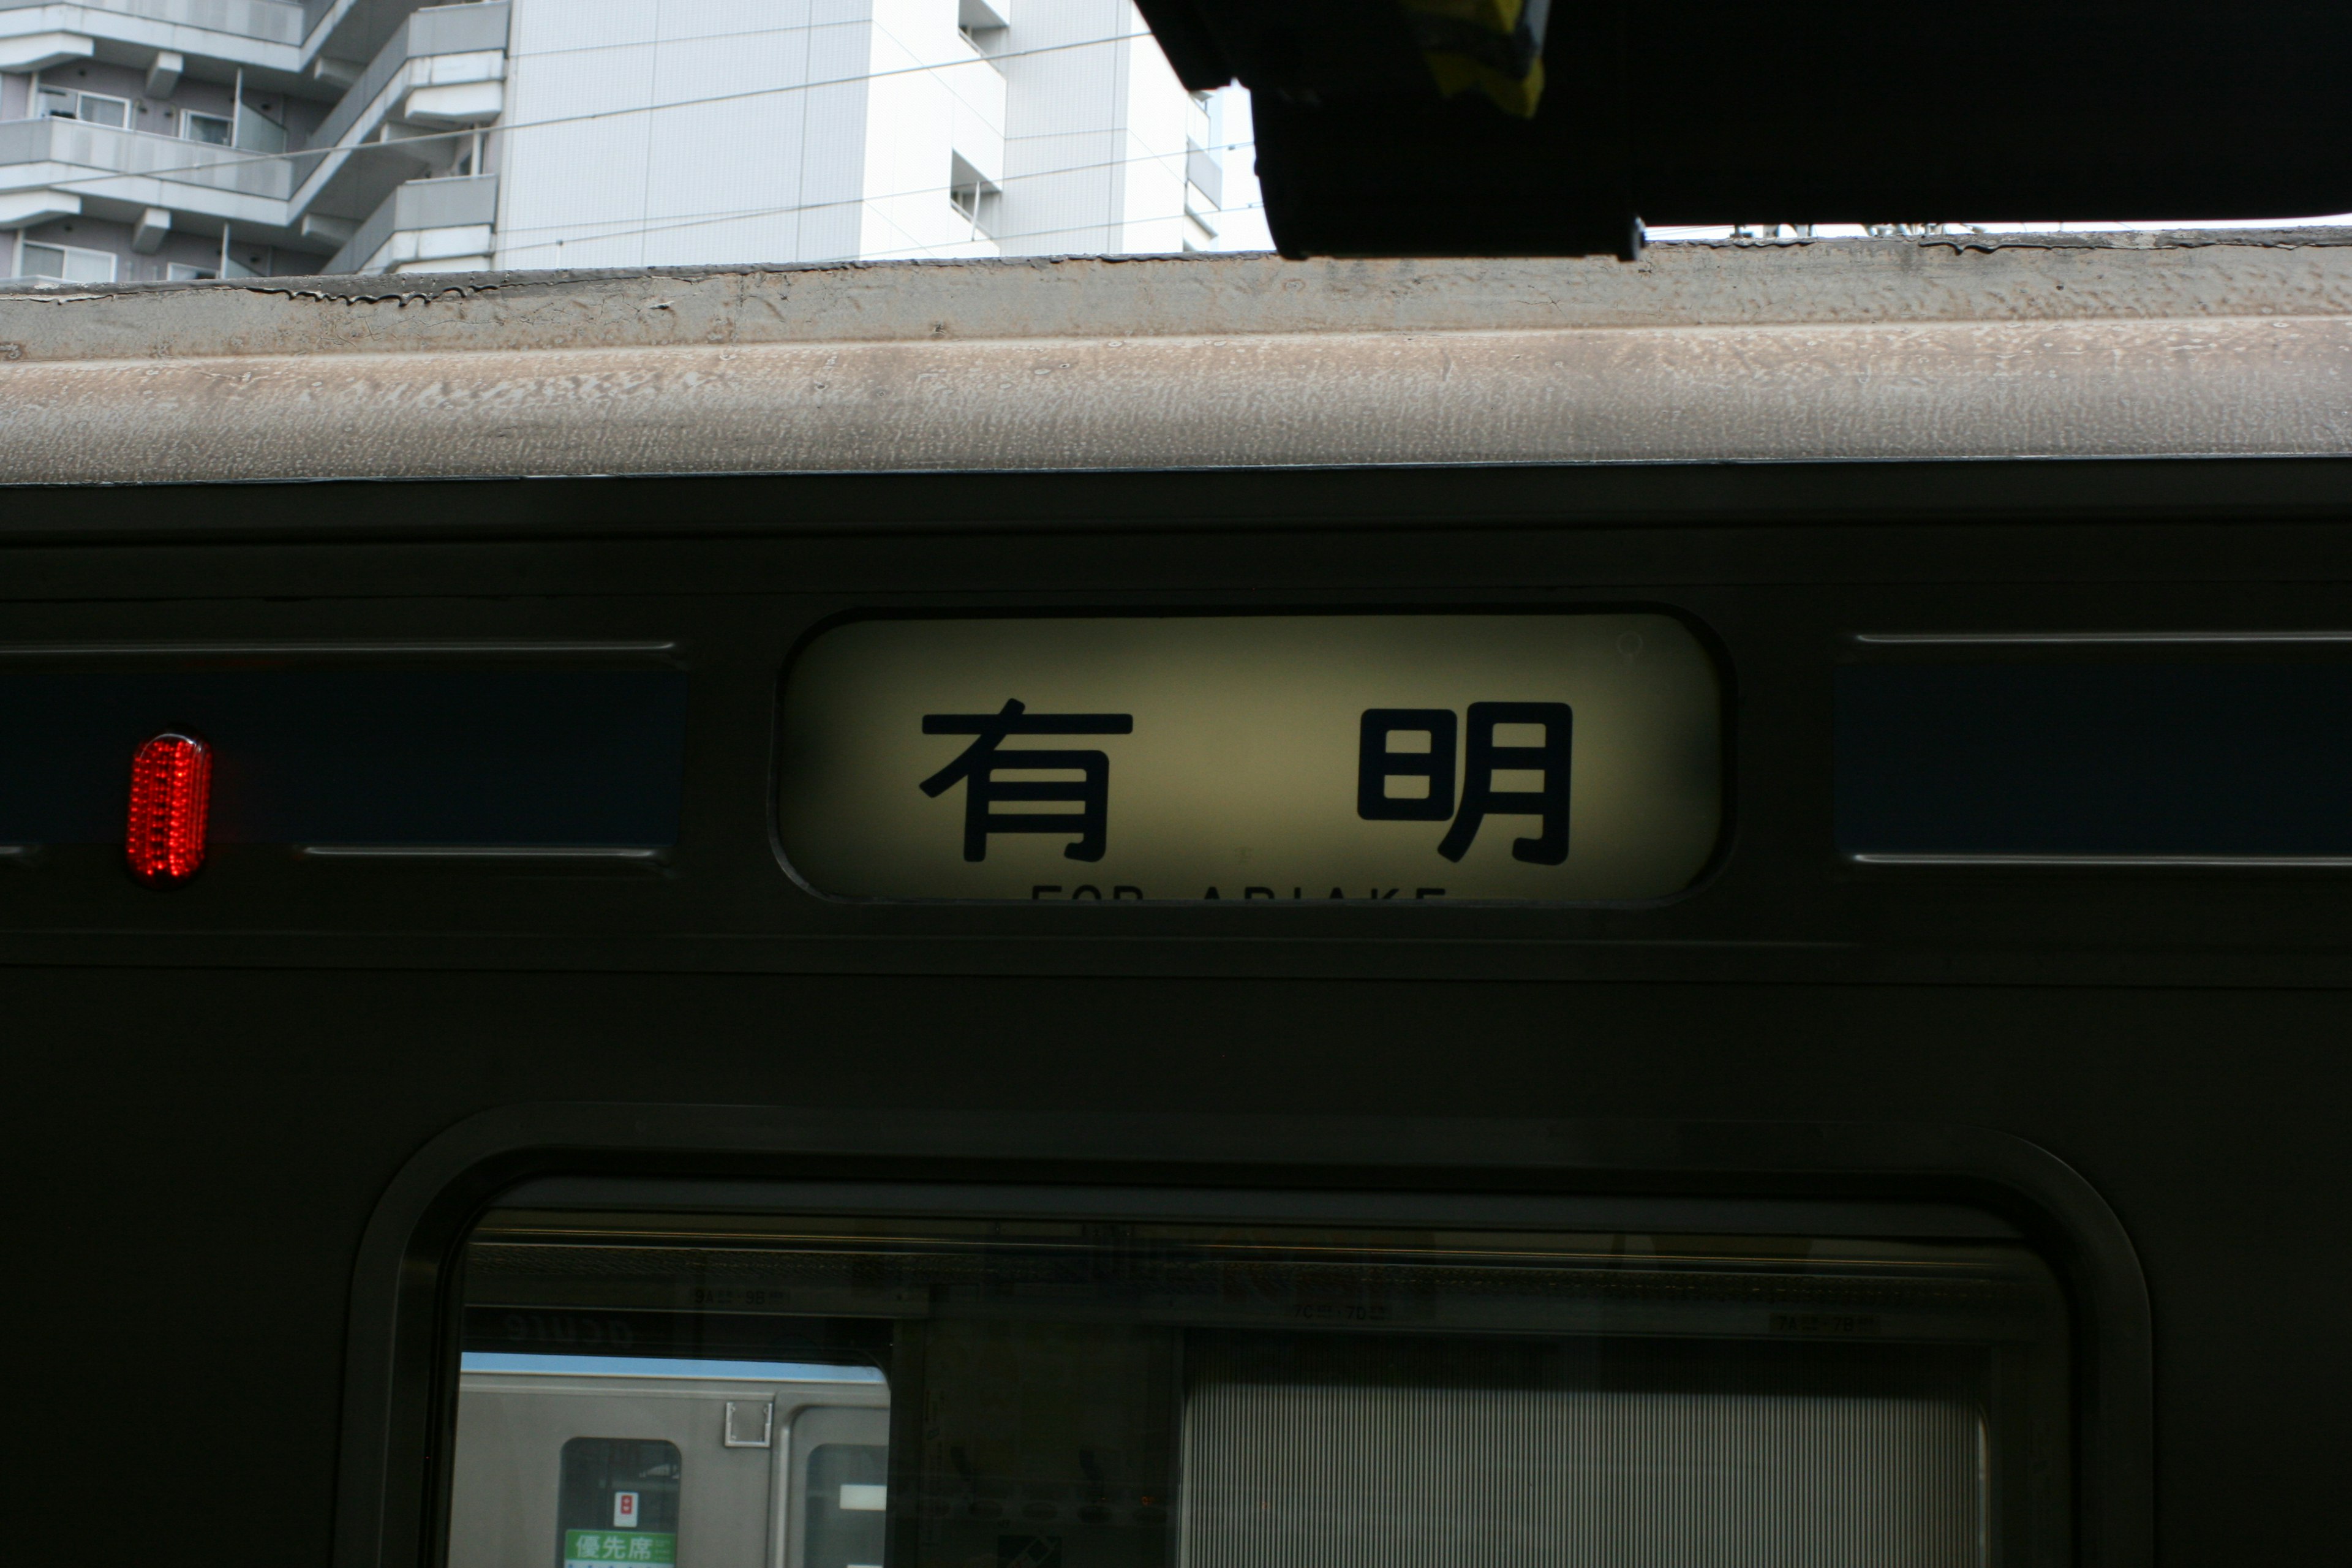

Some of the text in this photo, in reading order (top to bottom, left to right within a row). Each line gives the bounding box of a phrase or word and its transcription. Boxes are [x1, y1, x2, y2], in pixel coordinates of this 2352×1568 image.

[919, 697, 1574, 865] 有明
[1346, 1305, 1366, 1320] 7D
[1833, 1316, 1853, 1332] 7B
[575, 1534, 654, 1561] 優先席
